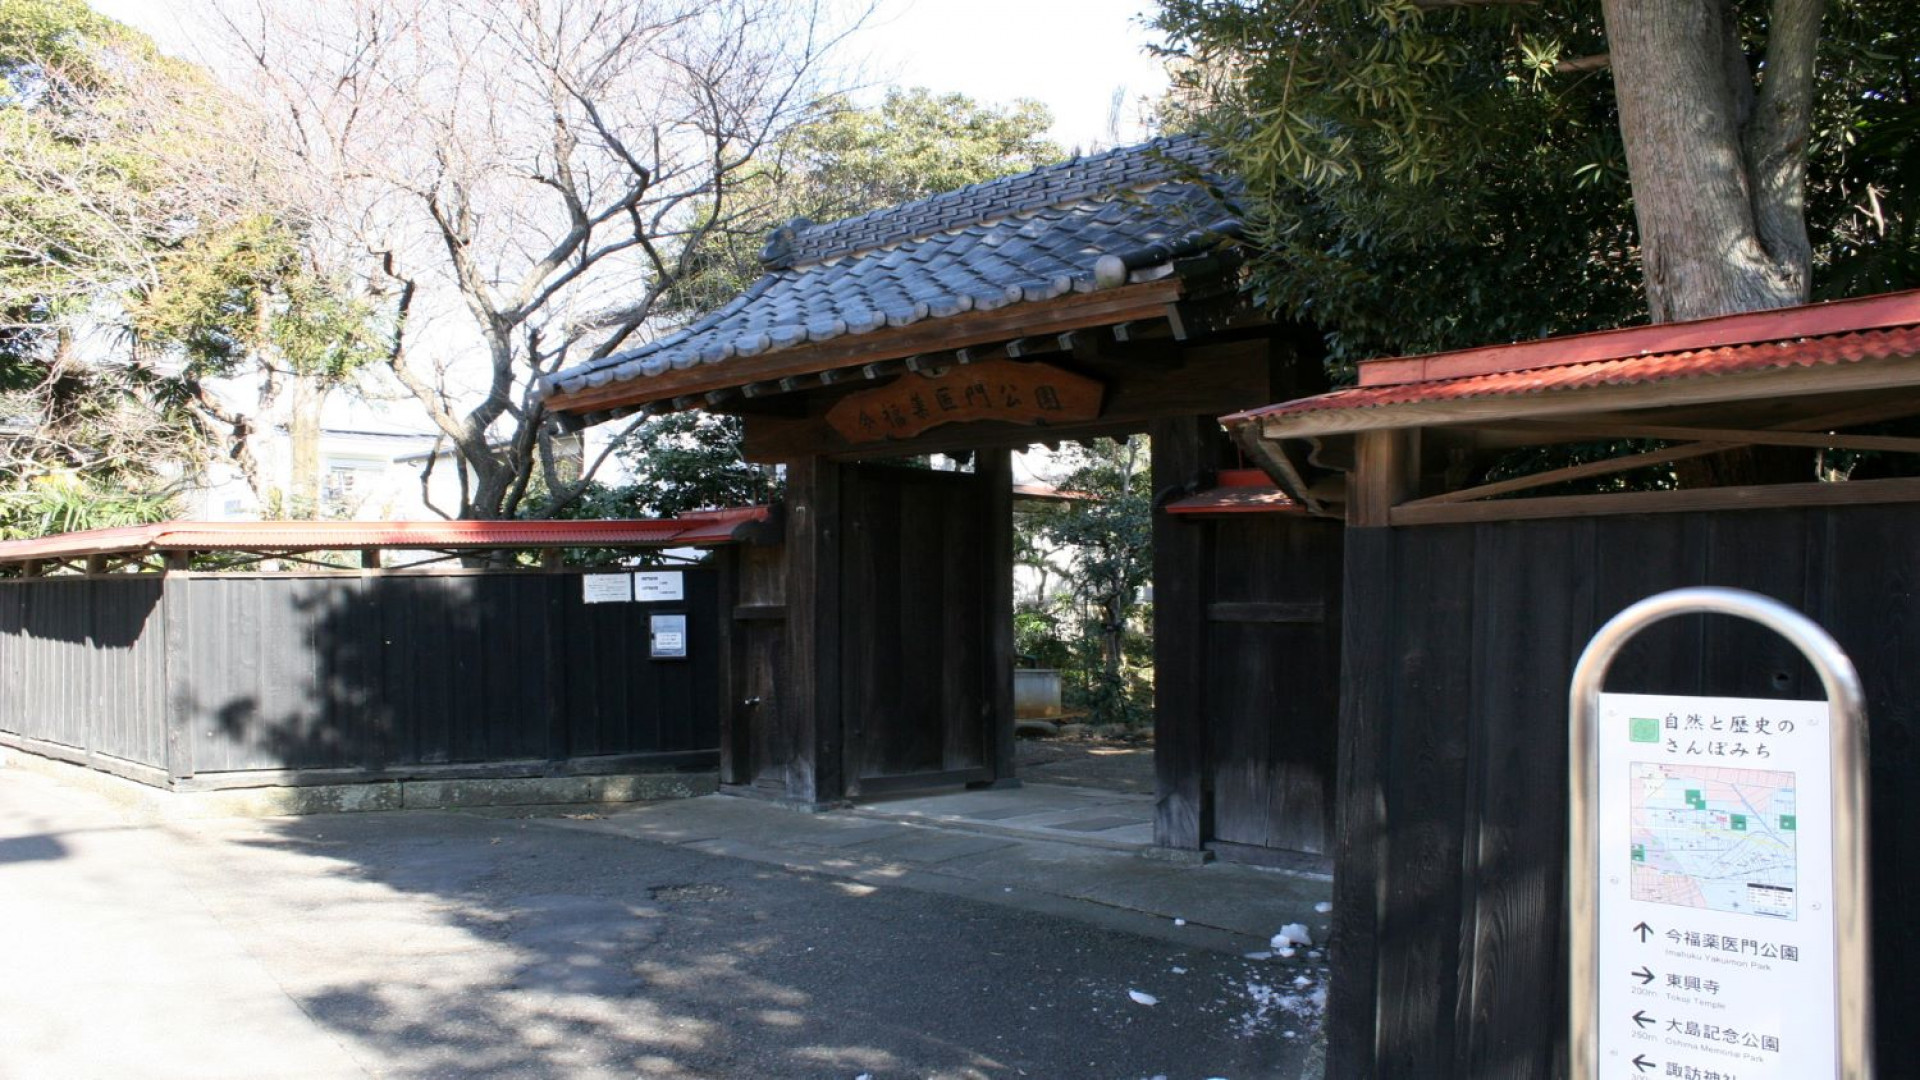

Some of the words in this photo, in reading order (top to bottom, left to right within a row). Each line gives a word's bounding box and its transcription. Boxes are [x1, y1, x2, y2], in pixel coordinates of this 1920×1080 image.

[1664, 713, 1795, 735] 自然と歴史の
[1666, 738, 1770, 759] さんぽみち
[1665, 928, 1799, 962] 今福薬医門公園
[1750, 962, 1771, 972] Park
[1631, 986, 1657, 997] 200m
[1666, 973, 1720, 995] 東興寺
[1694, 997, 1726, 1009] Temple
[1666, 1018, 1780, 1053] 大島記念公園
[1743, 1052, 1764, 1063] Park
